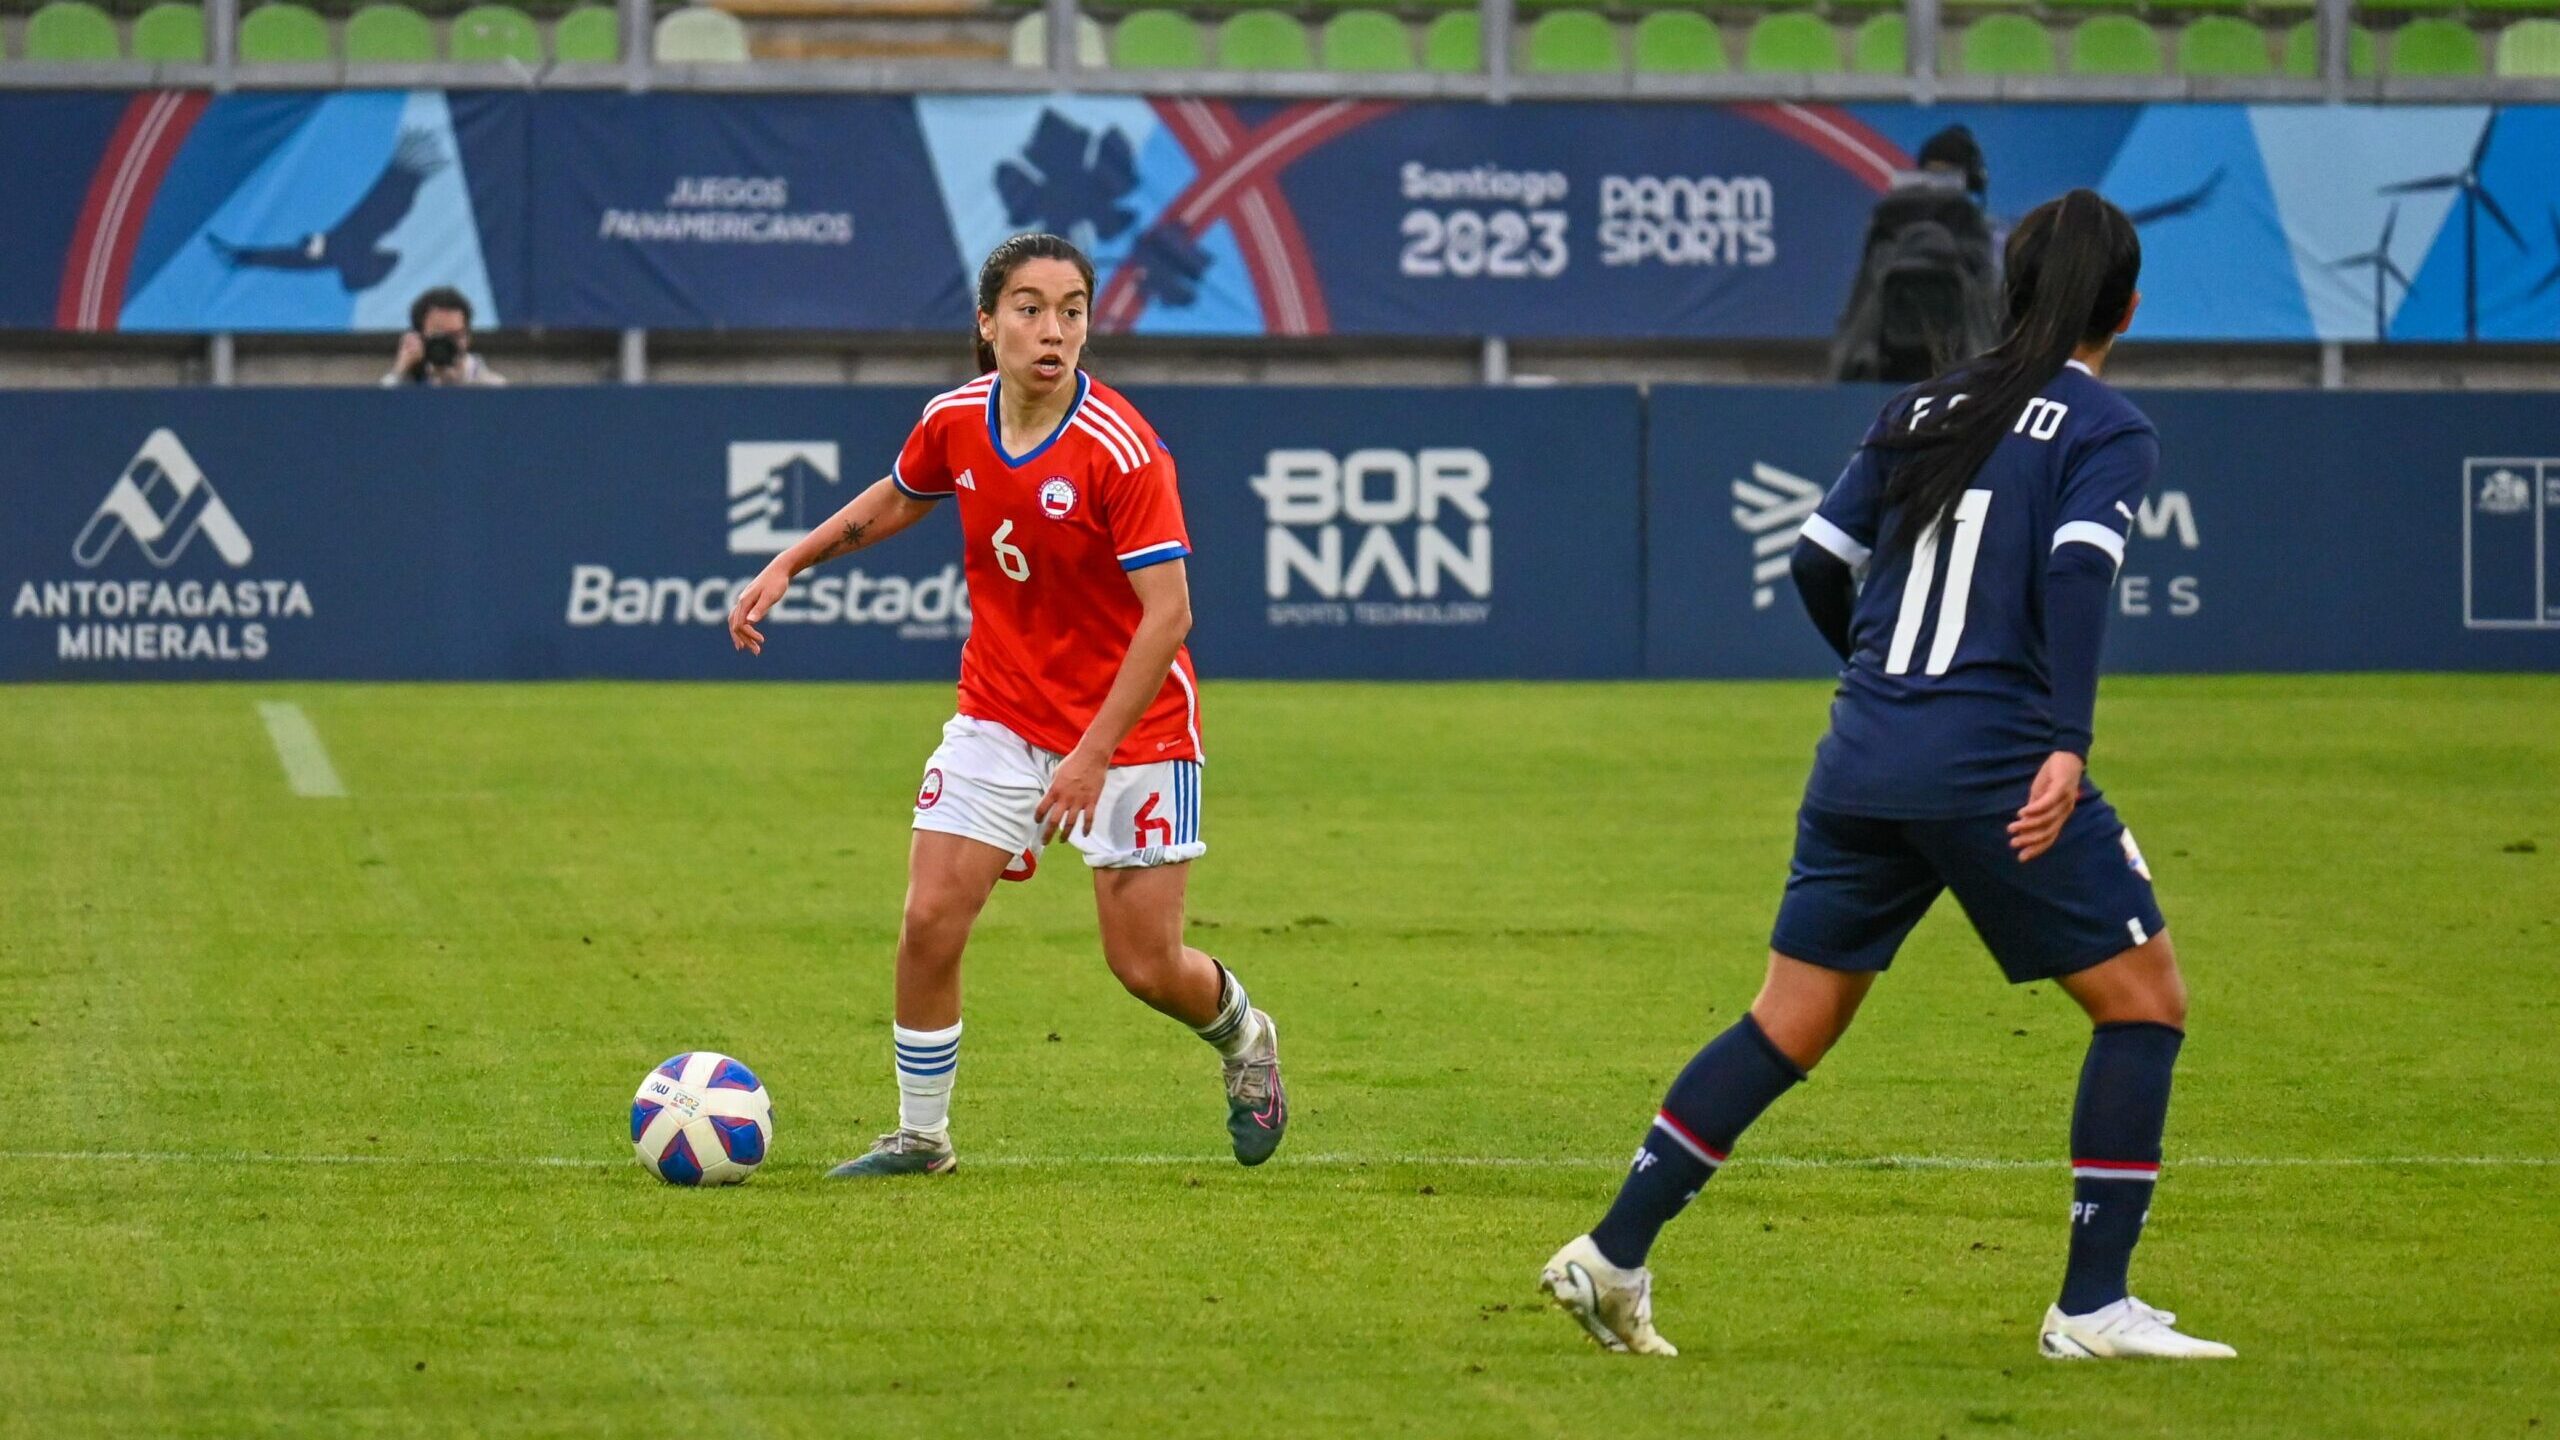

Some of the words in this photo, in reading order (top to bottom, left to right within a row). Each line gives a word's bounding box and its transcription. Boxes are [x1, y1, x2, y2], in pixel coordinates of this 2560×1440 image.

[665, 176, 788, 208] JUEGOS
[1401, 161, 1568, 205] Santiago
[1603, 175, 1772, 221] PANAM
[600, 208, 854, 244] PANAMERICANOS
[1400, 210, 1569, 275] 2023
[1600, 219, 1776, 266] SPORTS
[1251, 449, 1491, 525] BOR
[991, 519, 1031, 582] 6
[1267, 523, 1492, 599] NAN
[12, 580, 314, 617] ANTOFAGASTA
[566, 563, 973, 625] BancEstad
[1885, 489, 1993, 676] 11
[57, 622, 270, 660] MINERALS
